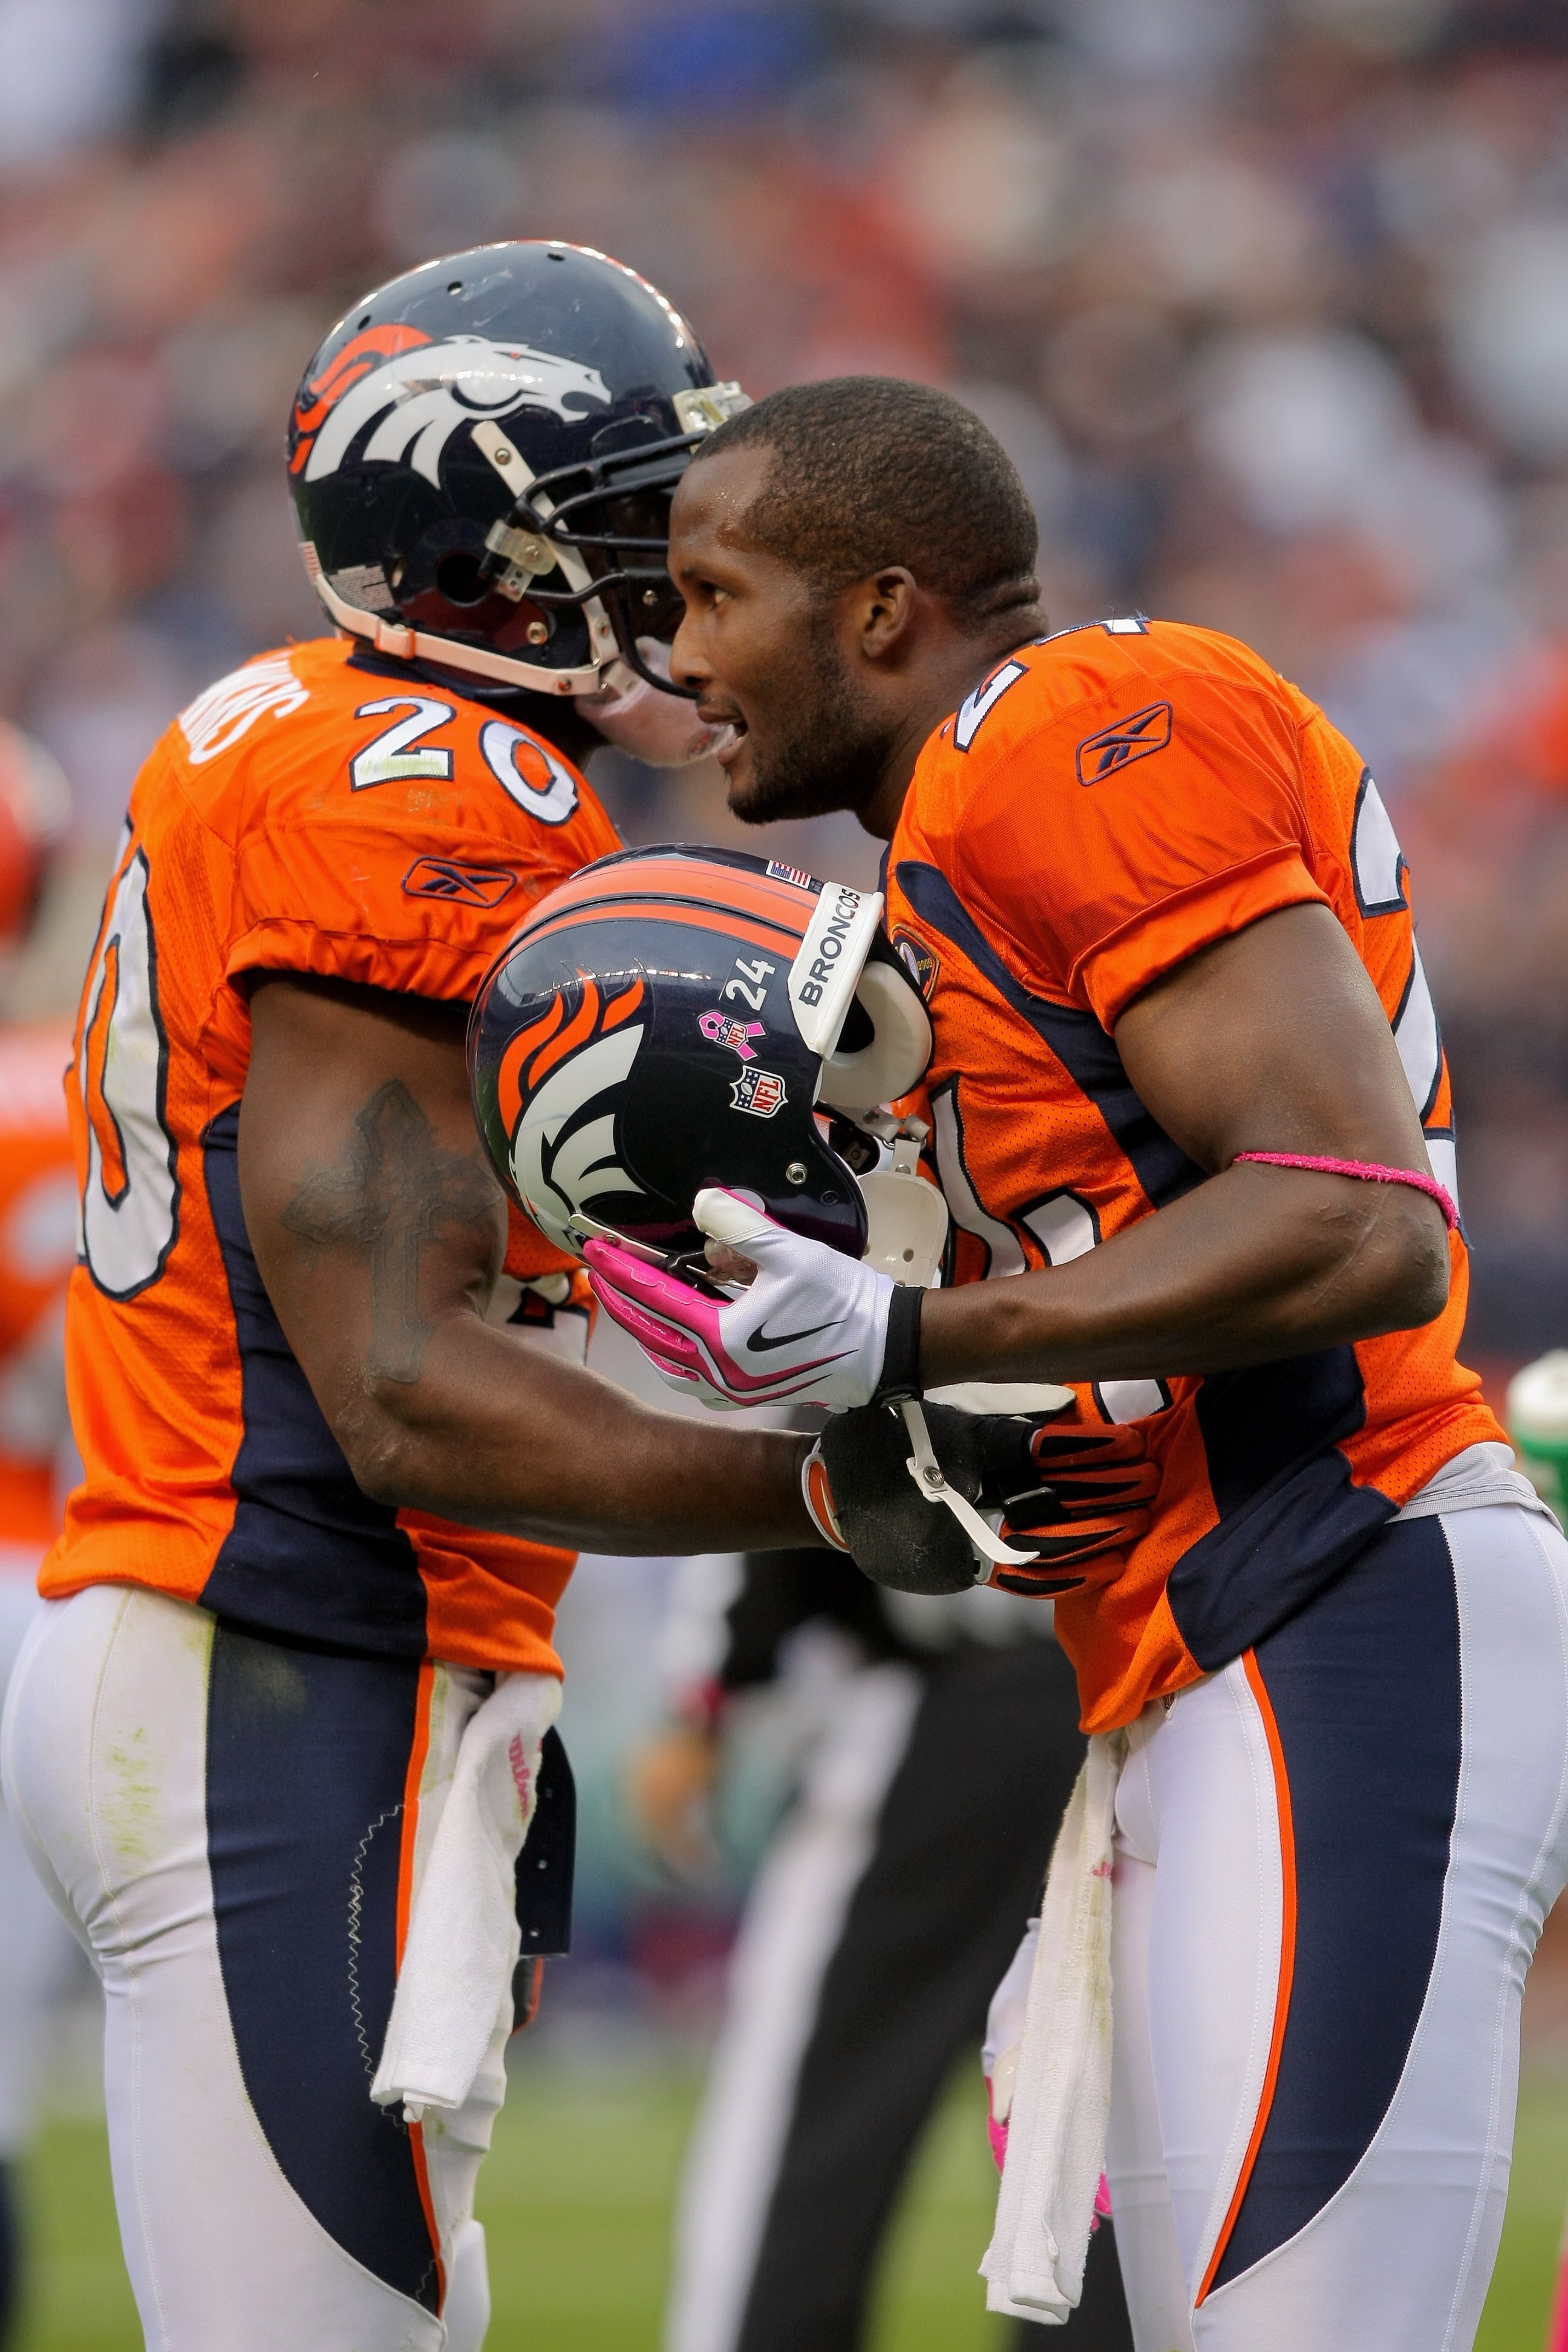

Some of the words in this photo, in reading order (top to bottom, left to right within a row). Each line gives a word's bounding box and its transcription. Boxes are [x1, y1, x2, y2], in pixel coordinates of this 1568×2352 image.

[350, 696, 580, 825] 20
[799, 888, 861, 1007] BRONCOS
[725, 958, 776, 1011] 24
[727, 1027, 745, 1047] NFL
[752, 1079, 780, 1112] NFL
